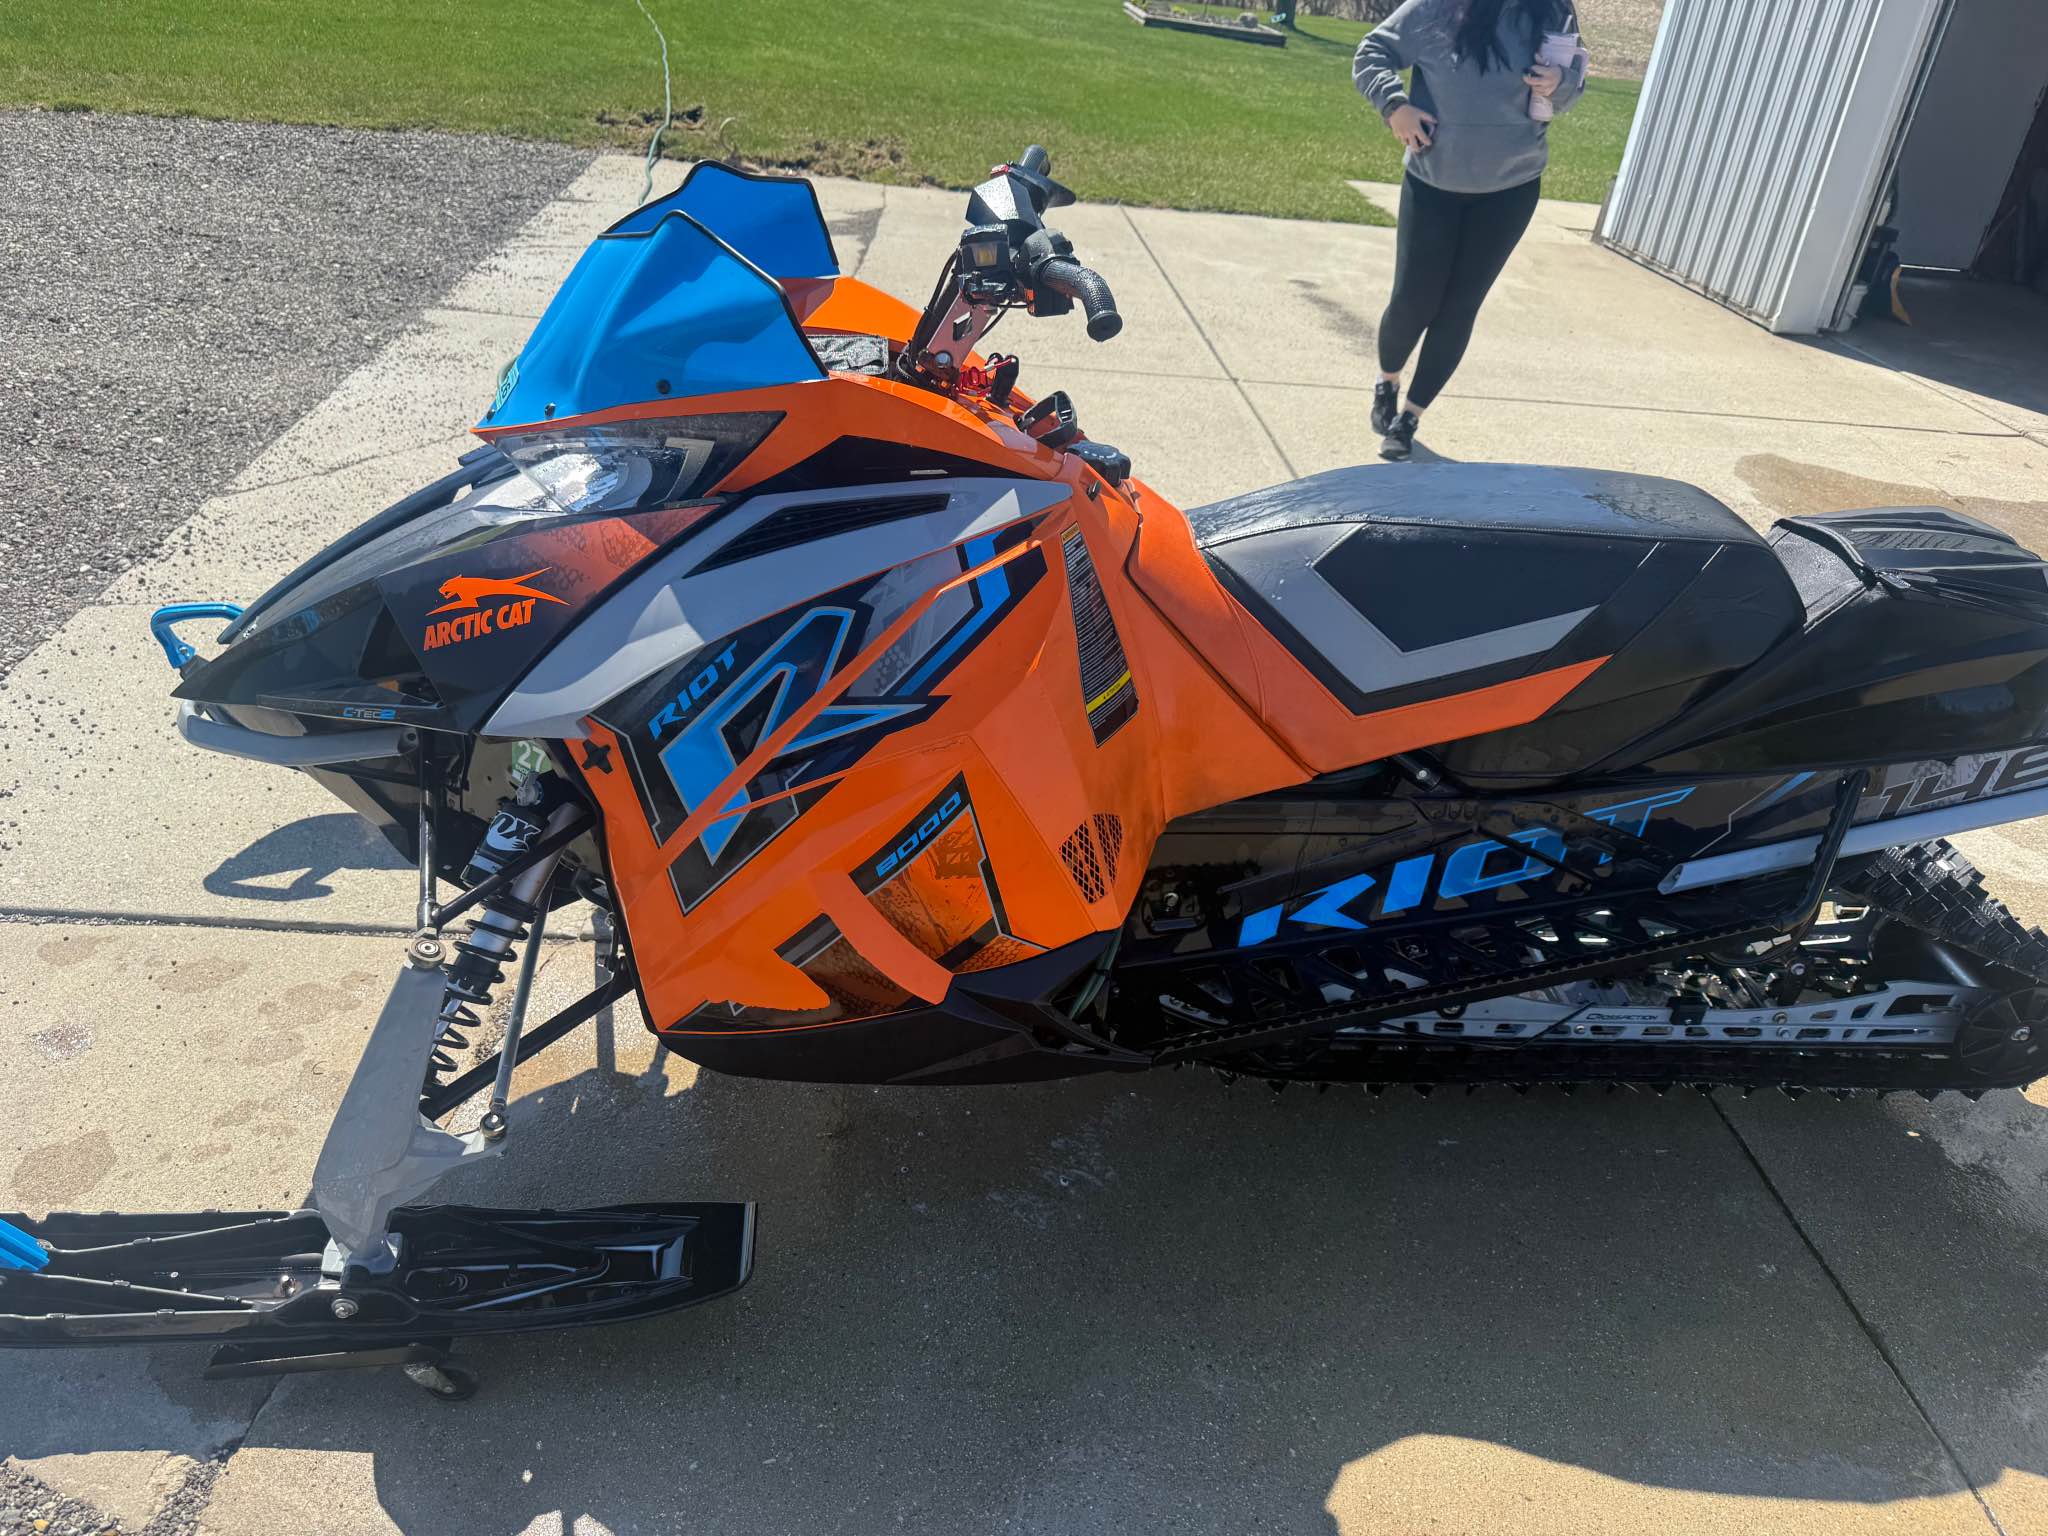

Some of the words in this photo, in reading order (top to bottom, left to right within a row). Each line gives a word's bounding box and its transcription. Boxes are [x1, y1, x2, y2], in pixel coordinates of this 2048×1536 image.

[423, 608, 493, 651] ARCTIC
[496, 598, 536, 630] CAT
[647, 639, 738, 740] RIOT
[488, 810, 542, 848] OX
[875, 791, 961, 878] 8000
[1237, 786, 1697, 948] RIOT
